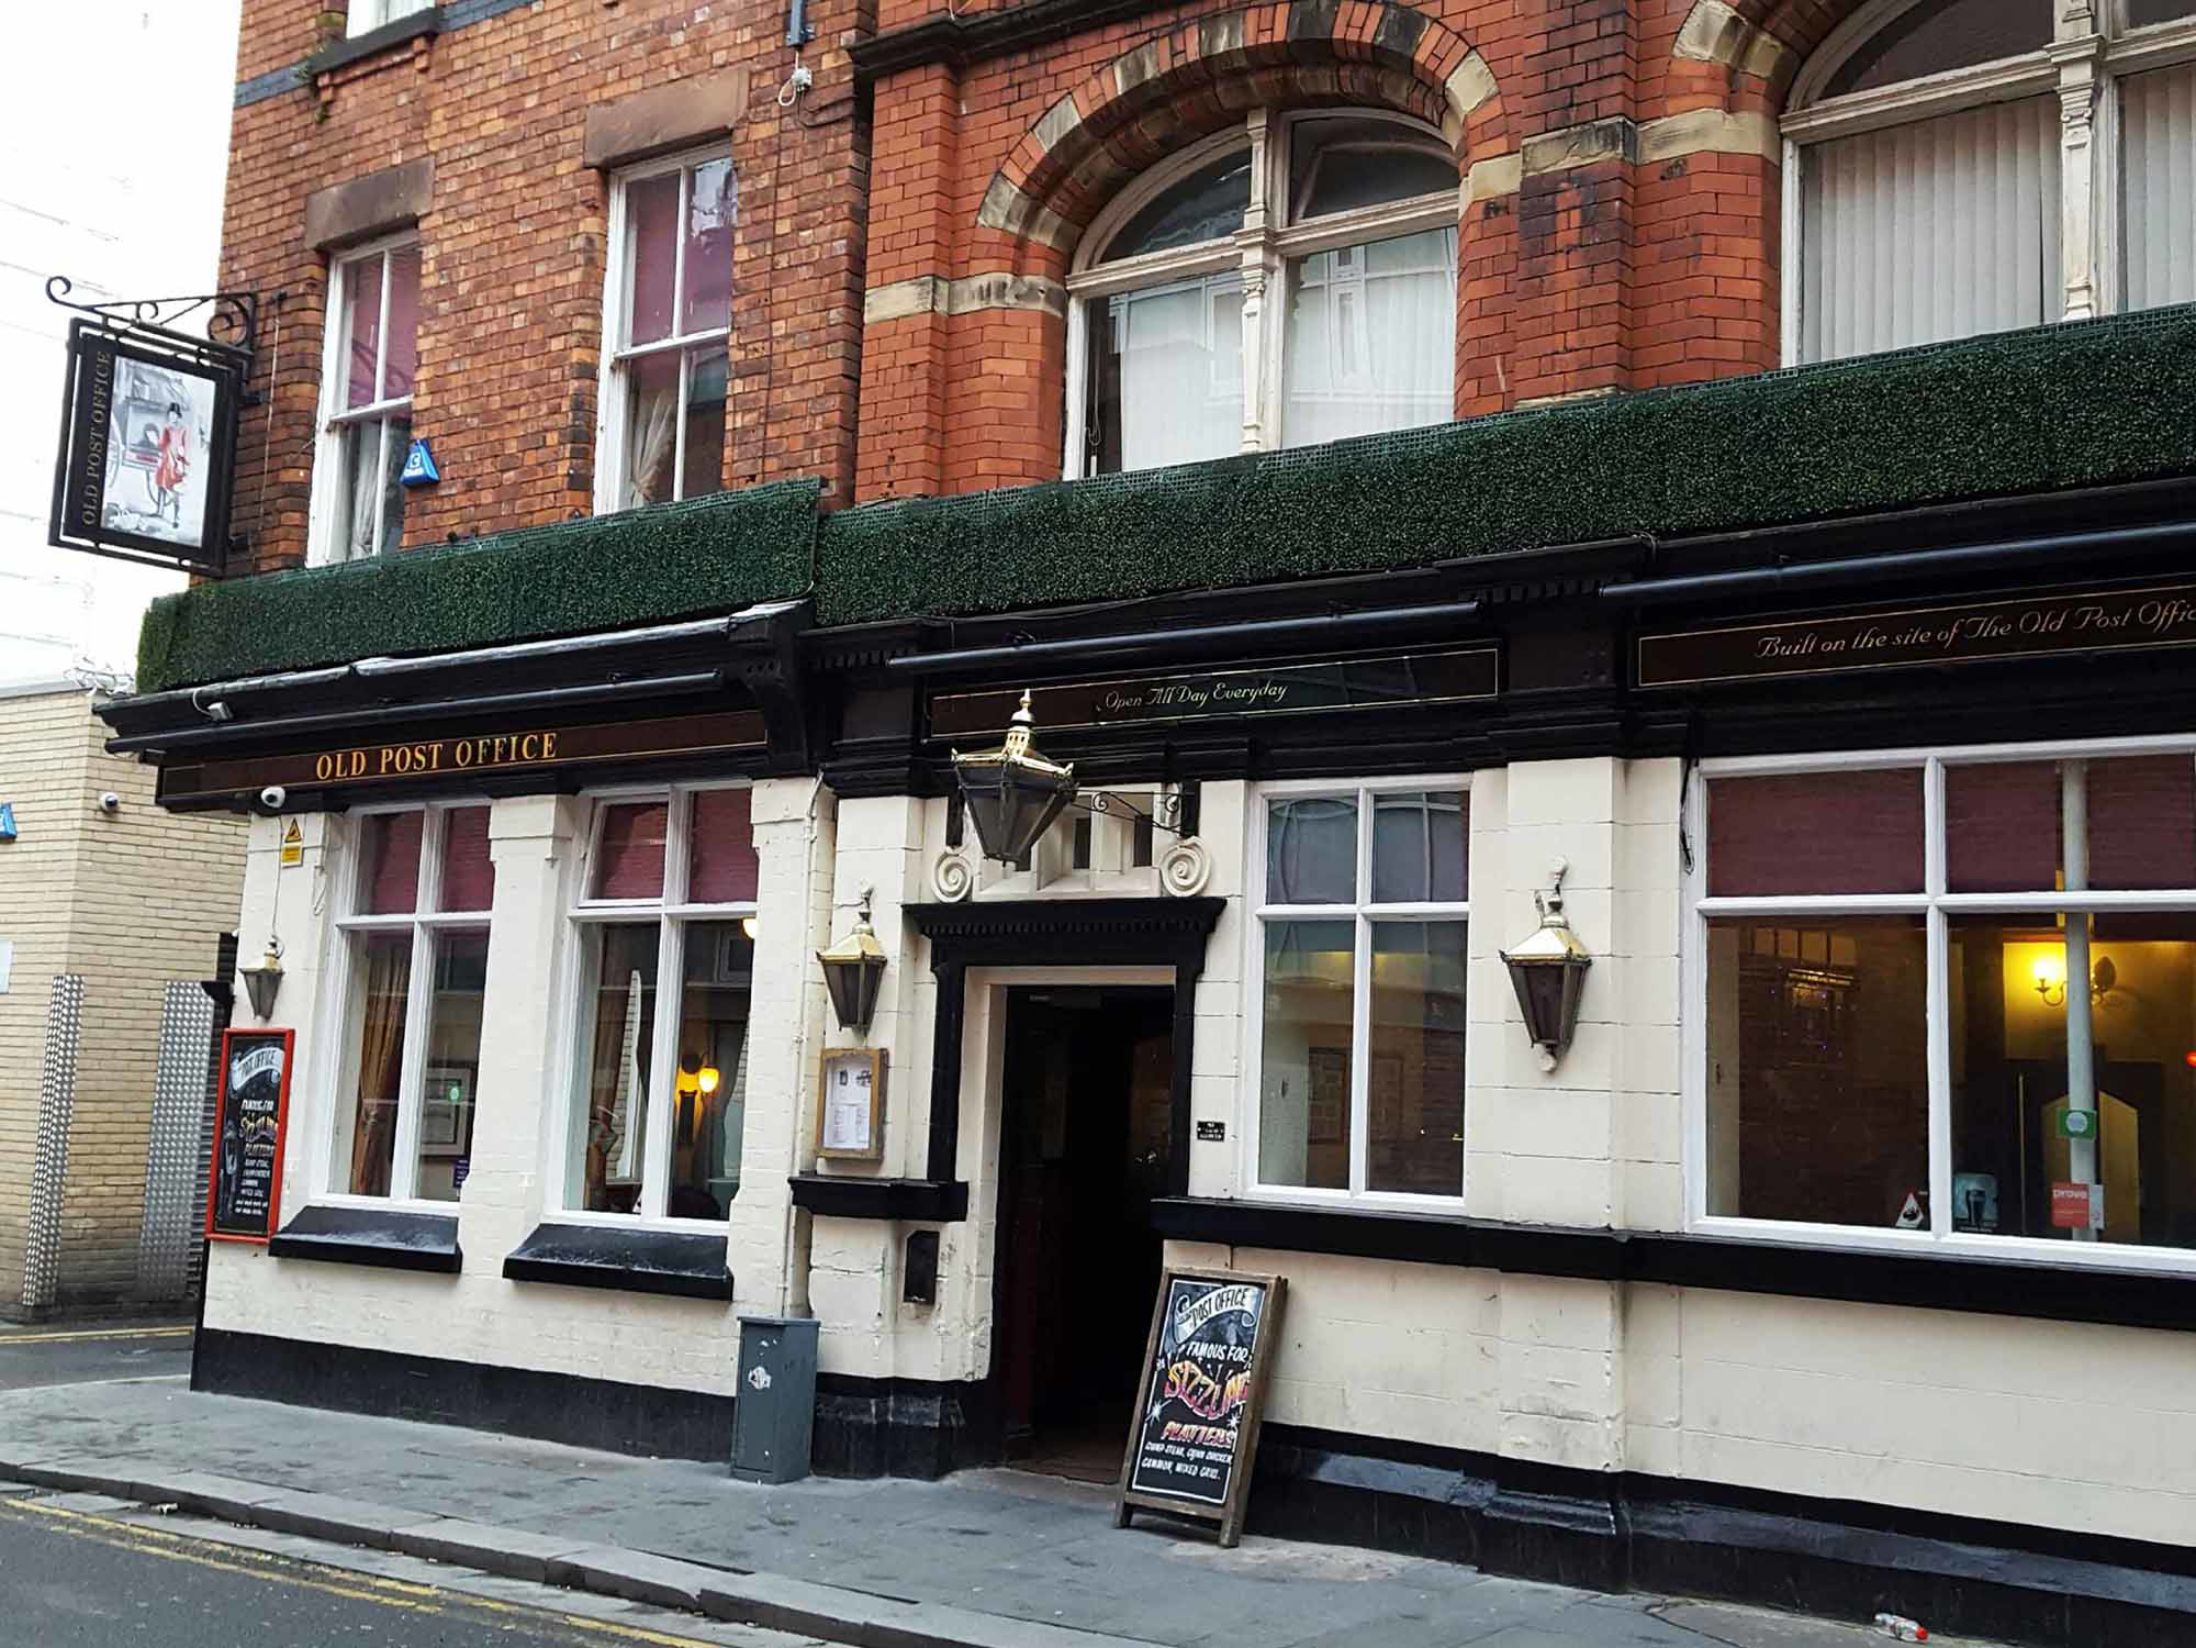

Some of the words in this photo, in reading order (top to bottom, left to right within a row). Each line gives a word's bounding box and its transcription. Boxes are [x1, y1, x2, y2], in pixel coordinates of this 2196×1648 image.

[93, 352, 111, 424] OFFICE
[87, 427, 103, 480] POST
[82, 483, 99, 525] OLD
[1755, 632, 1818, 658] Built
[1820, 639, 1846, 653] on
[1851, 626, 1887, 650] the
[1891, 627, 1932, 647] site
[1936, 618, 1965, 650] of
[1963, 614, 2012, 639] The
[2018, 607, 2071, 634] Old
[2072, 604, 2133, 630] Post
[1105, 690, 1143, 712] Open
[1146, 686, 1177, 706] All
[1175, 685, 1210, 709] Day
[1212, 679, 1289, 705] Everyday
[315, 750, 367, 780] OLD
[379, 743, 444, 774] POST
[455, 732, 558, 768] OFFICE
[1191, 1297, 1212, 1327] POST
[1214, 1287, 1249, 1312] OFFICE
[1186, 1340, 1226, 1360] FAMOUS
[1226, 1346, 1248, 1363] FOR
